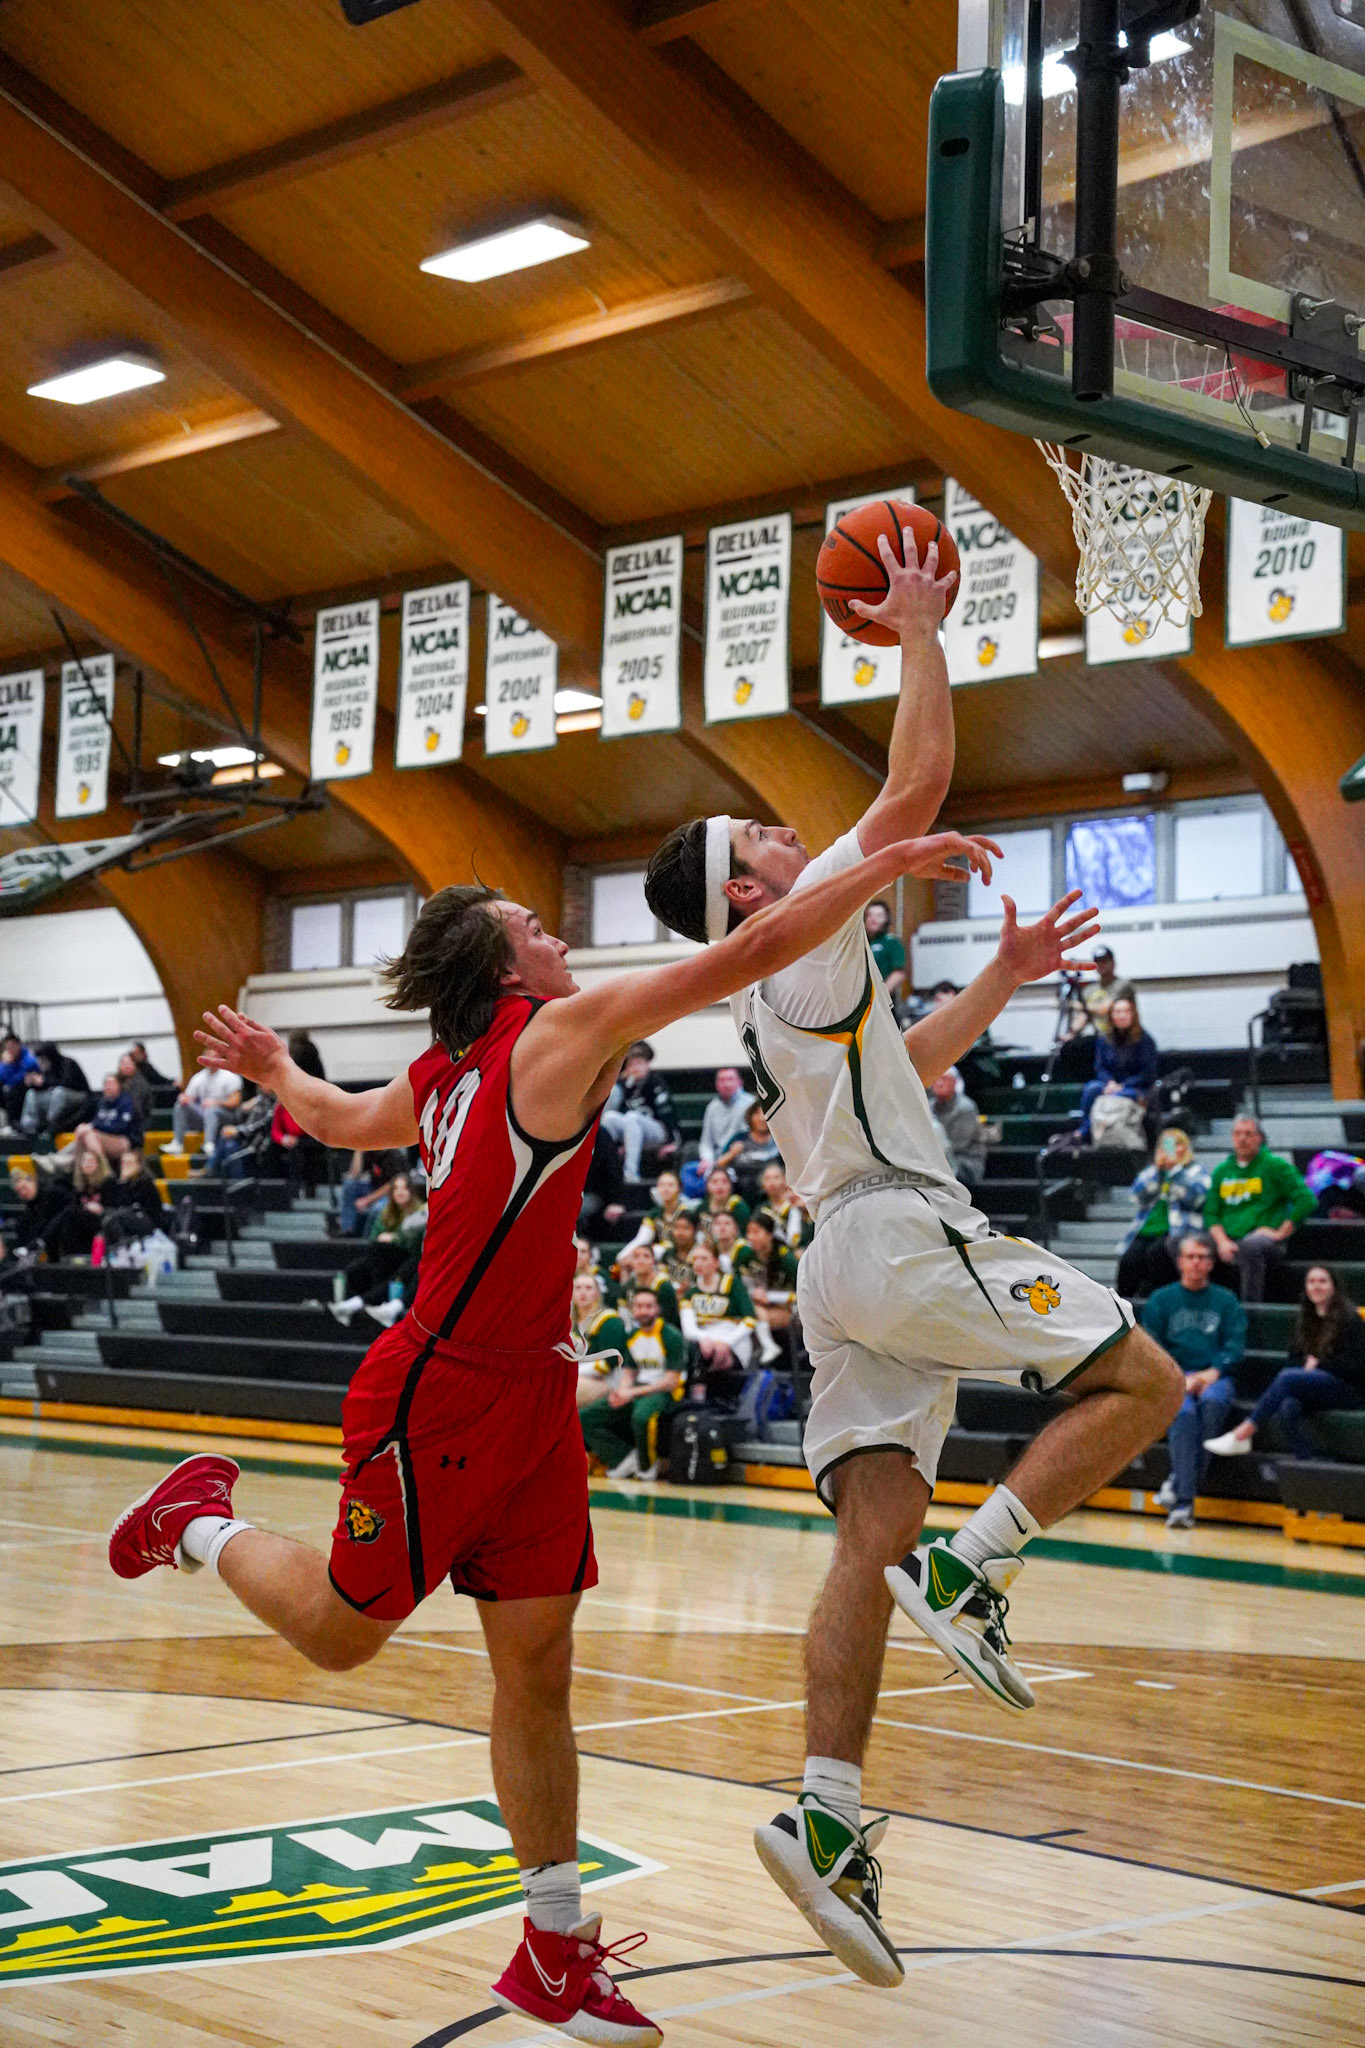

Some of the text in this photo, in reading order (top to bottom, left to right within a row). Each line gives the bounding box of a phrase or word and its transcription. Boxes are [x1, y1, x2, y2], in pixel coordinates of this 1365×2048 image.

[716, 525, 781, 555] DELVAL
[612, 547, 674, 575] DELVAL
[1254, 540, 1316, 578] 2010
[718, 564, 781, 601] NCAA
[408, 591, 462, 617] DELVAL
[613, 586, 673, 619] NCAA
[962, 592, 1018, 627] 2009
[322, 609, 371, 634] DELVAL
[408, 627, 459, 657] NCAA
[724, 638, 771, 669] 2007
[322, 644, 370, 674] NCAA
[617, 654, 664, 684] 2005
